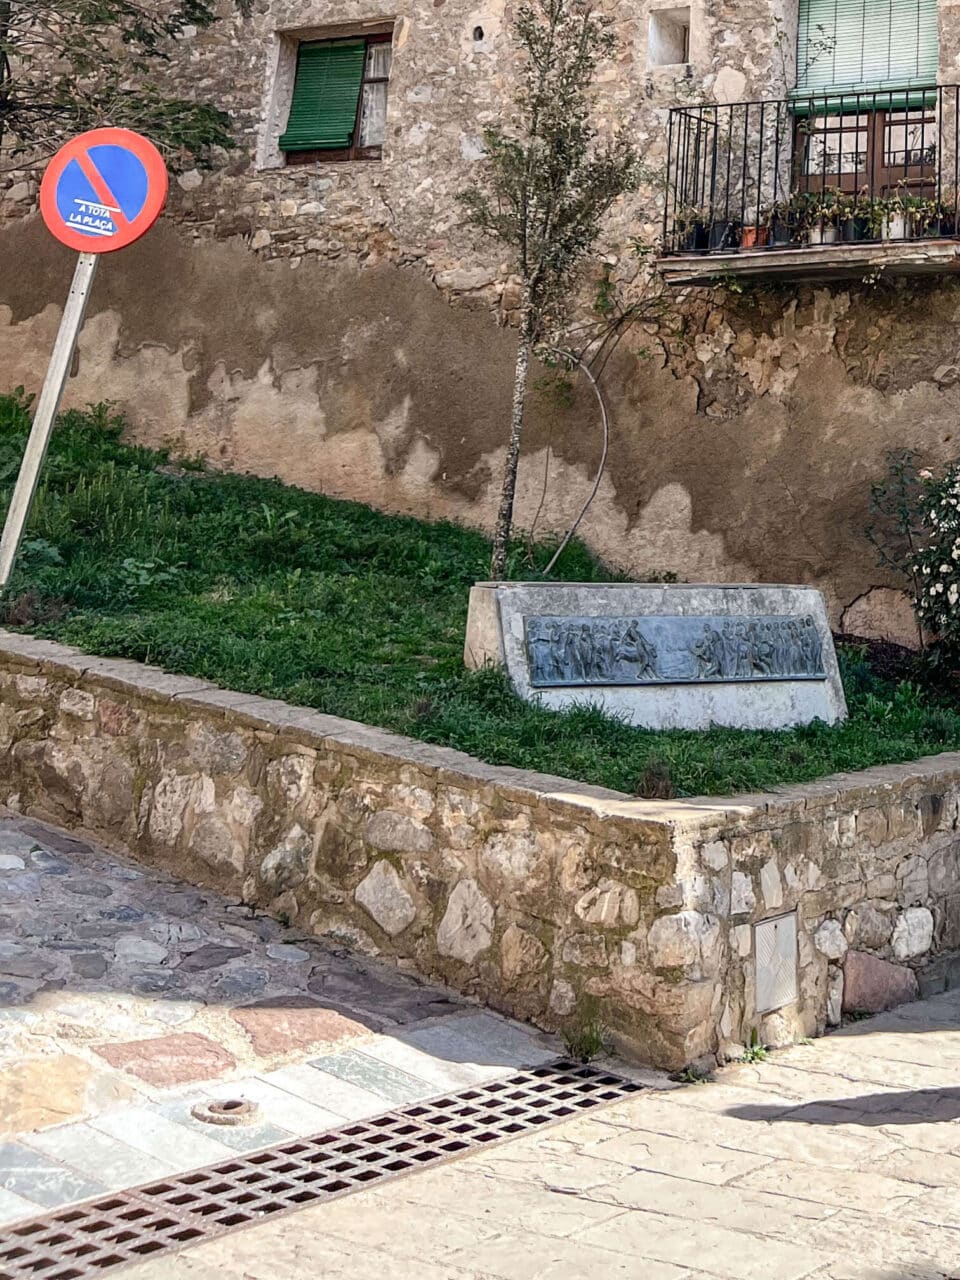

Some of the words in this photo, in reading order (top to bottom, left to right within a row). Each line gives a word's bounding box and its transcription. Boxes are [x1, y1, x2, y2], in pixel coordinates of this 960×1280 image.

[88, 206, 110, 218] TOTA
[69, 213, 82, 223] LA
[83, 216, 113, 230] PLAÇA
